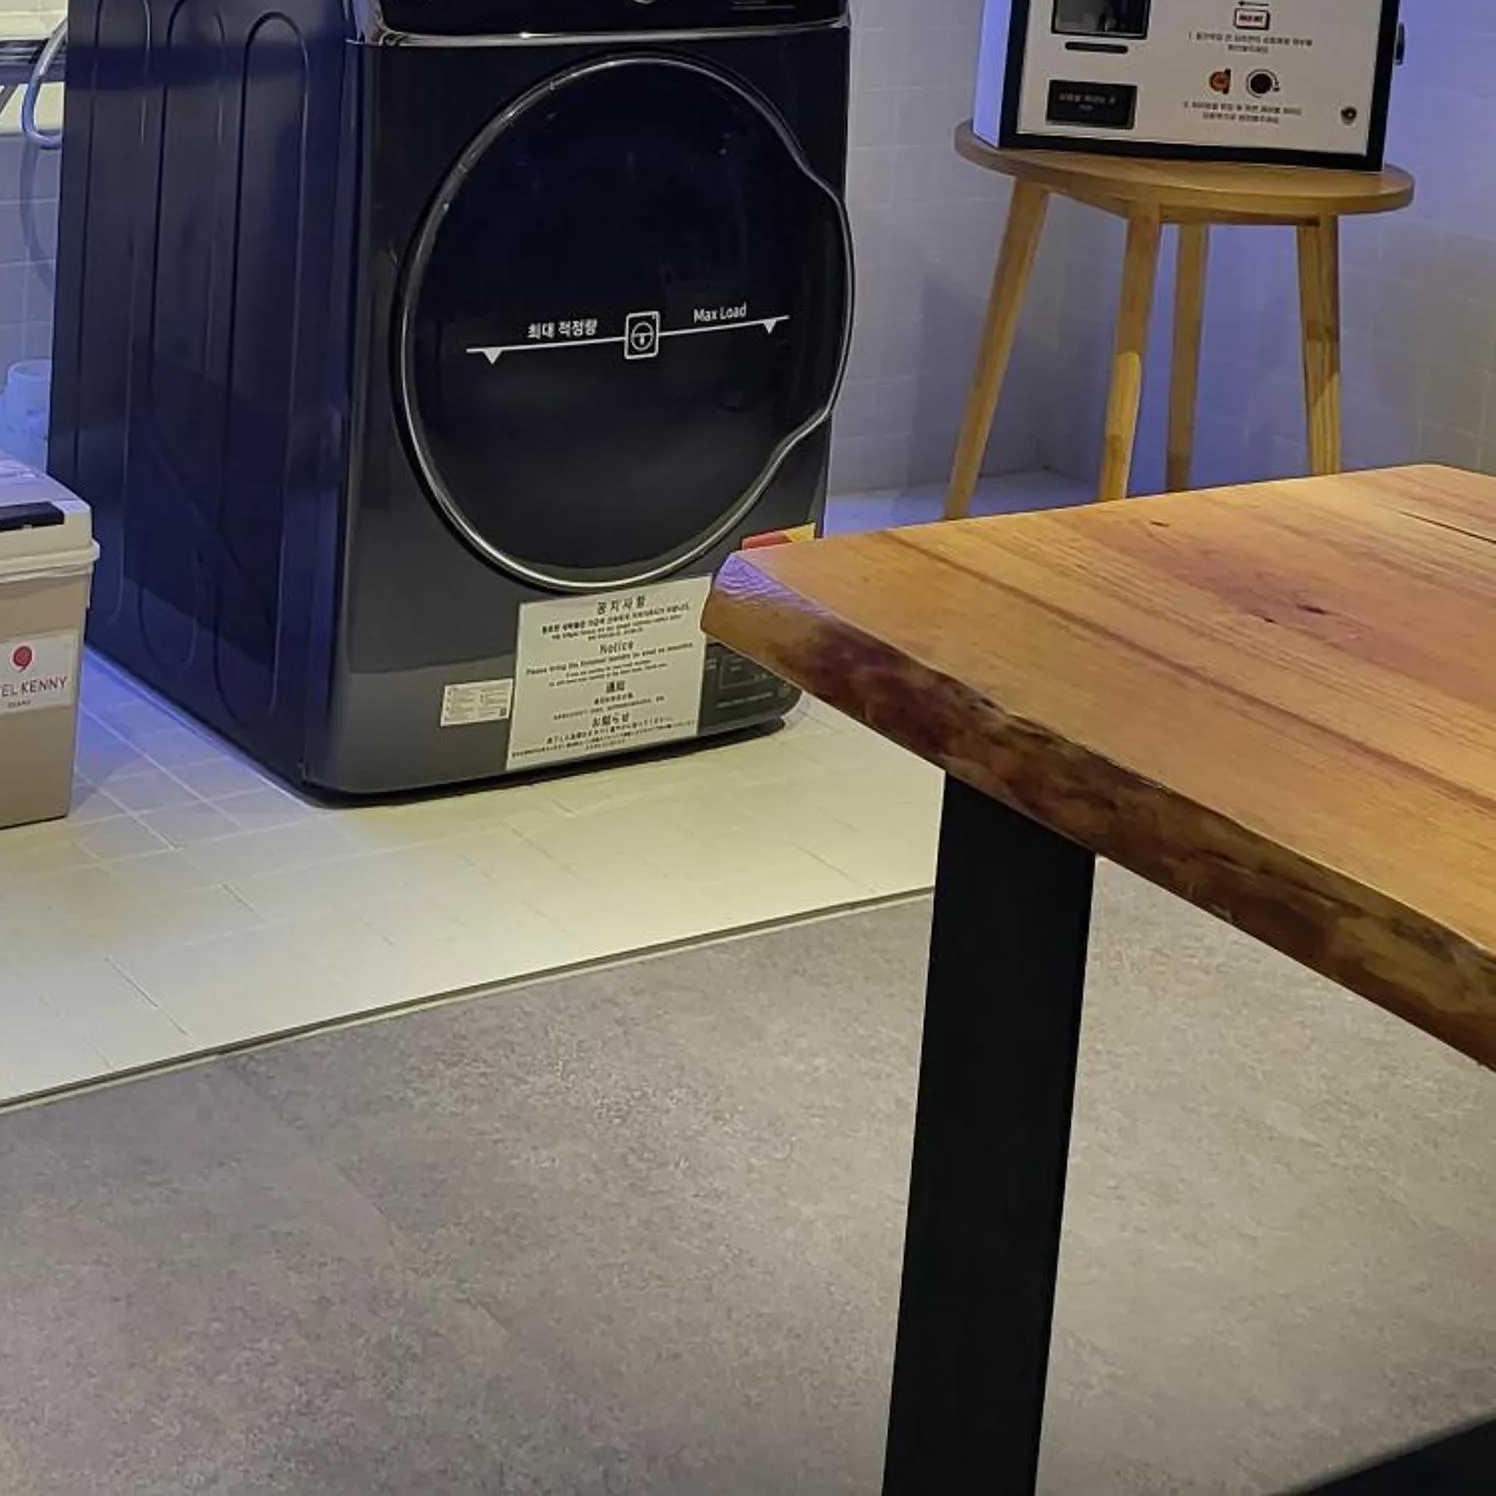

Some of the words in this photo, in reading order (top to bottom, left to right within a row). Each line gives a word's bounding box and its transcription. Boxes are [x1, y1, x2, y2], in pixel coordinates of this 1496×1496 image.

[692, 307, 718, 324] Max
[718, 301, 748, 320] Load
[527, 321, 555, 341] 최대
[558, 317, 599, 338] 적정량
[599, 639, 634, 655] Notice
[21, 675, 68, 694] KENNY
